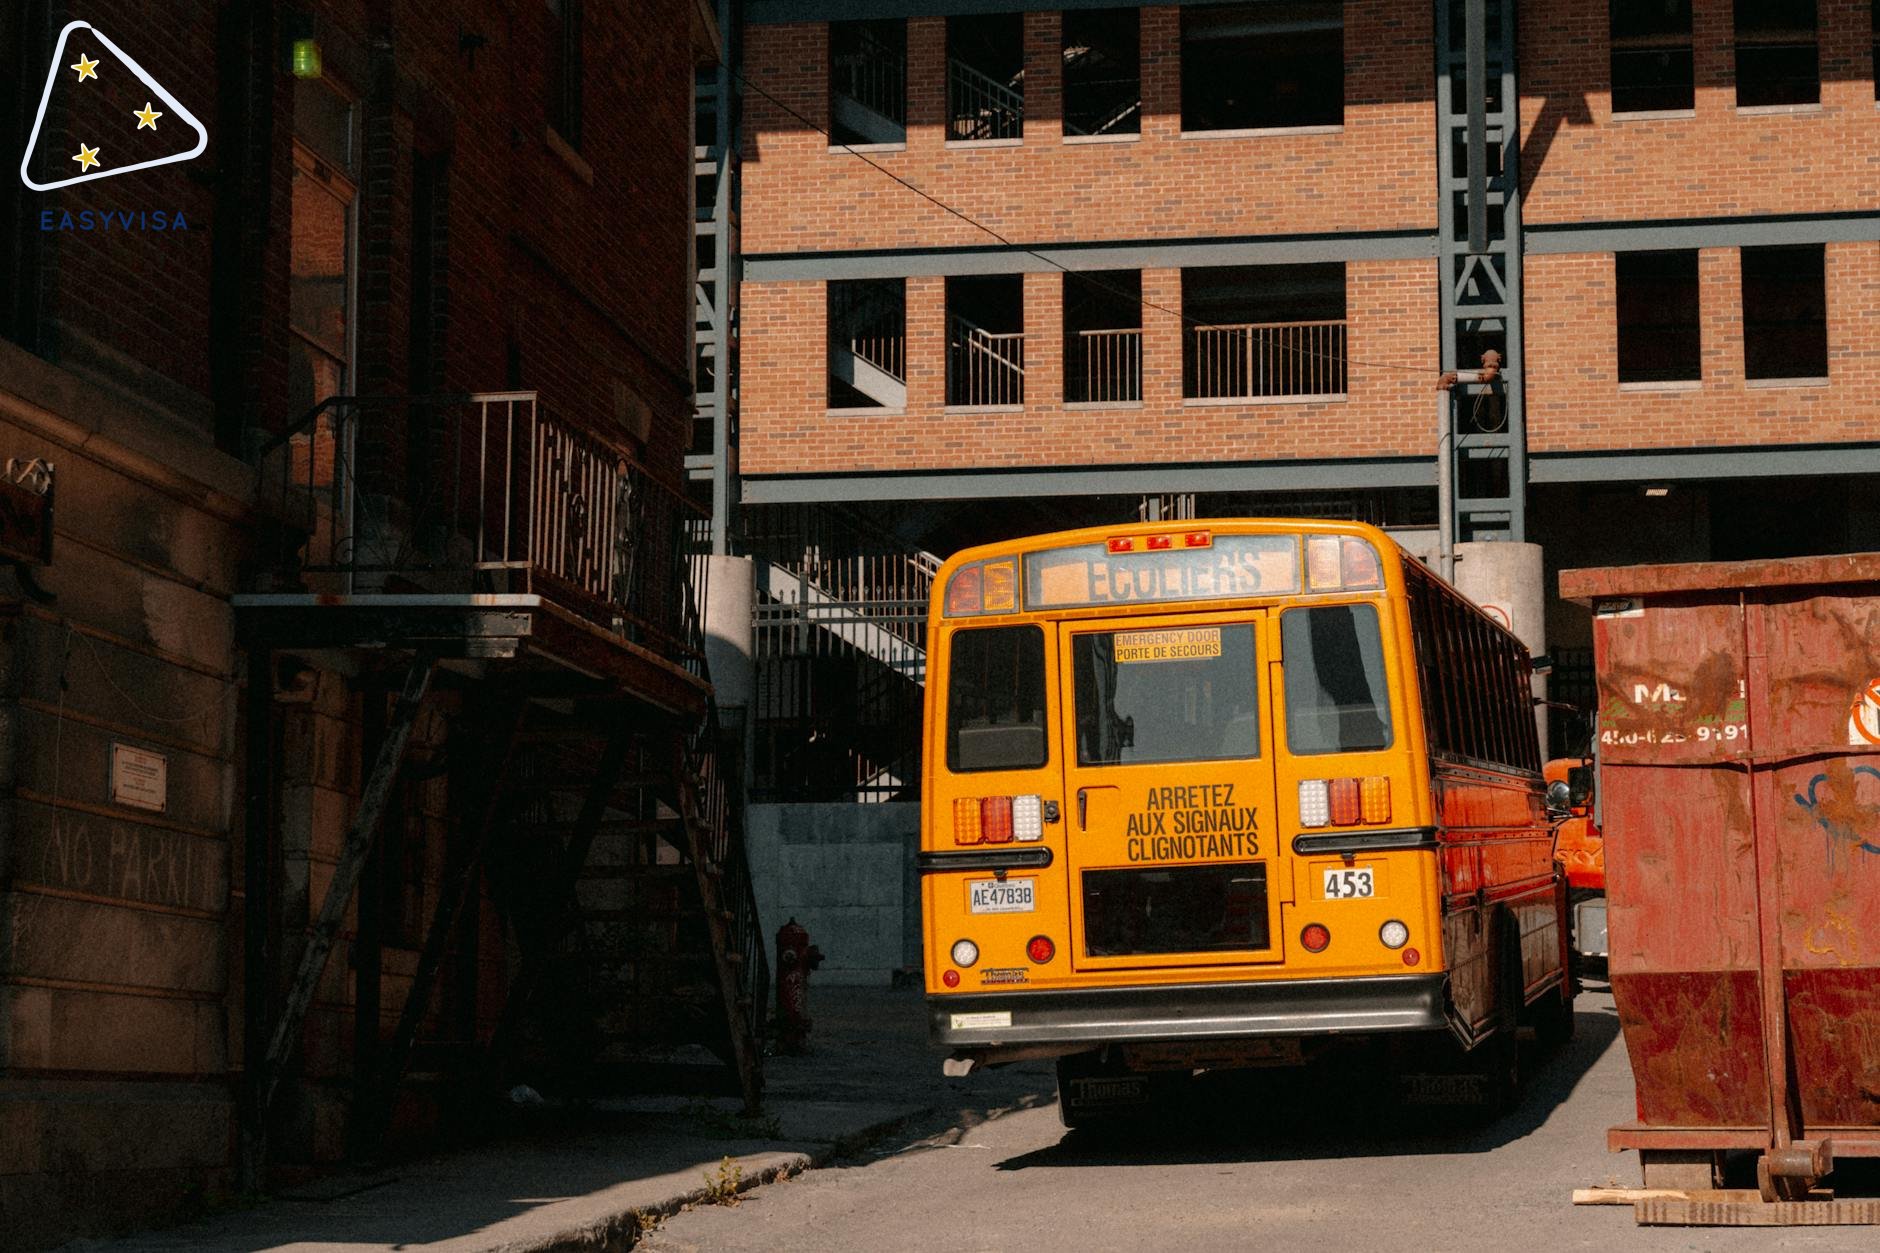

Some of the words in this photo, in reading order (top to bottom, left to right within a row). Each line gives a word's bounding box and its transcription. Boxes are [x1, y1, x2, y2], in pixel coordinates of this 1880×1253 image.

[1116, 630, 1184, 646] EMERGENCY
[1187, 629, 1219, 643] DOOR
[1117, 647, 1150, 660] PORTE
[1153, 647, 1166, 658] DE
[1170, 644, 1219, 657] SECOURS
[1147, 783, 1235, 811] ARRETEZ
[1127, 812, 1166, 837] AUX
[1173, 807, 1258, 835] SIGNAUX
[1127, 832, 1259, 862] CLIGNOTANTS
[973, 887, 1032, 906] AE47838
[1326, 871, 1372, 898] 453
